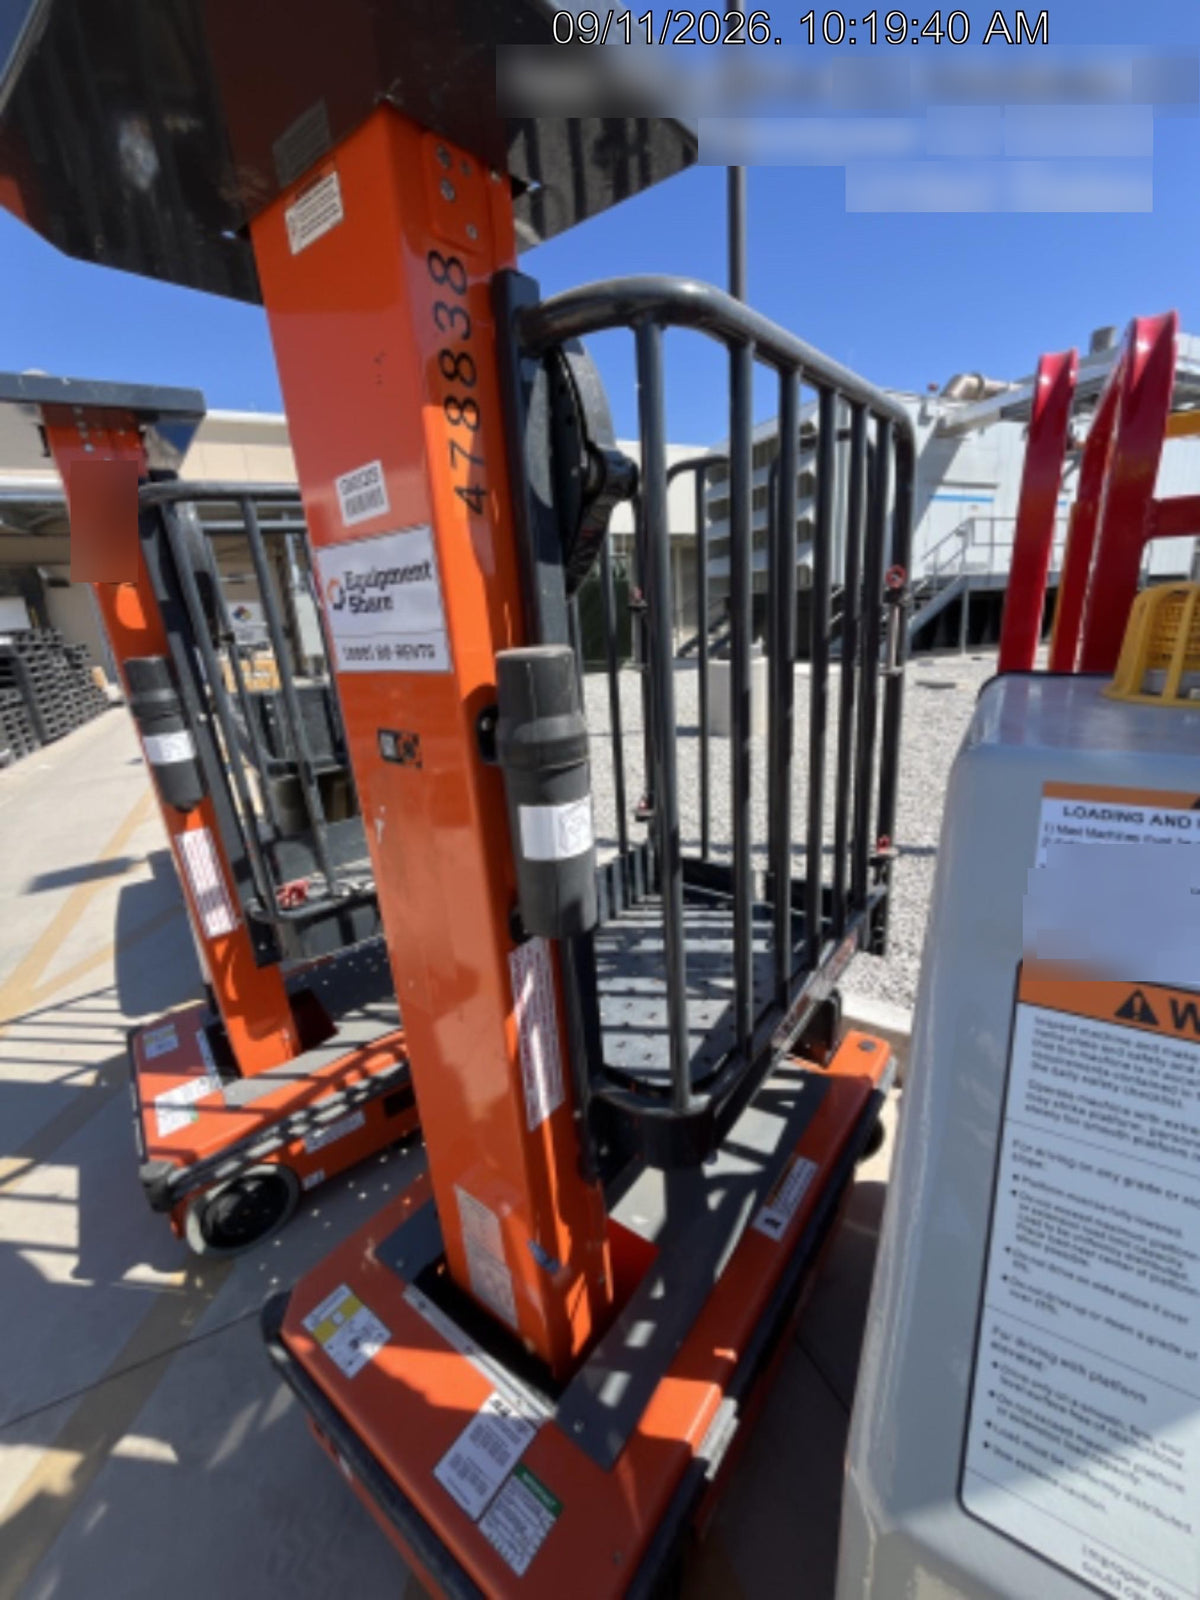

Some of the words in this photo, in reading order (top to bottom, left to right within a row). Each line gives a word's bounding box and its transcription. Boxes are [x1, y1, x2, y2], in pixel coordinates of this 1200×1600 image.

[427, 249, 487, 516] 478838
[1063, 805, 1145, 825] LOADING
[1149, 813, 1193, 830] AND
